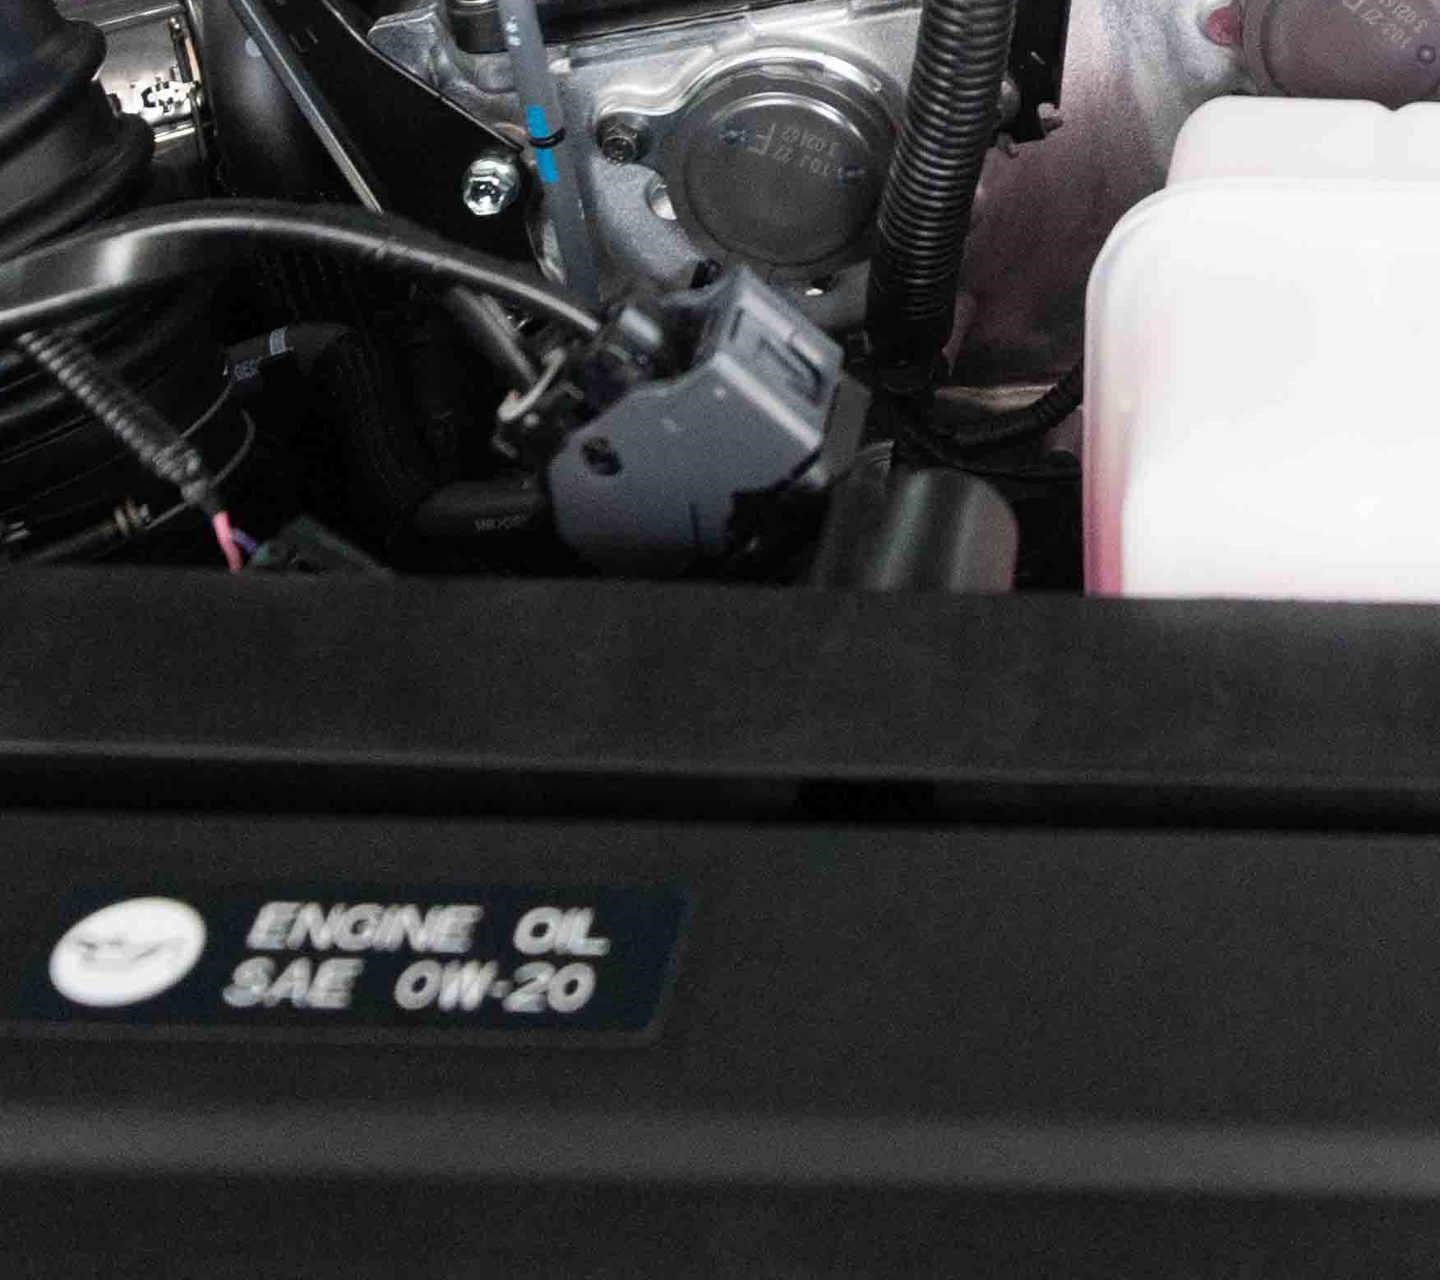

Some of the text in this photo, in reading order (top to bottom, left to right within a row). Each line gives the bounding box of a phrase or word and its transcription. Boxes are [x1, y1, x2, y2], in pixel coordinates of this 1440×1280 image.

[247, 900, 610, 957] ENGINE OIL
[222, 956, 596, 1013] SAE 0W-20
